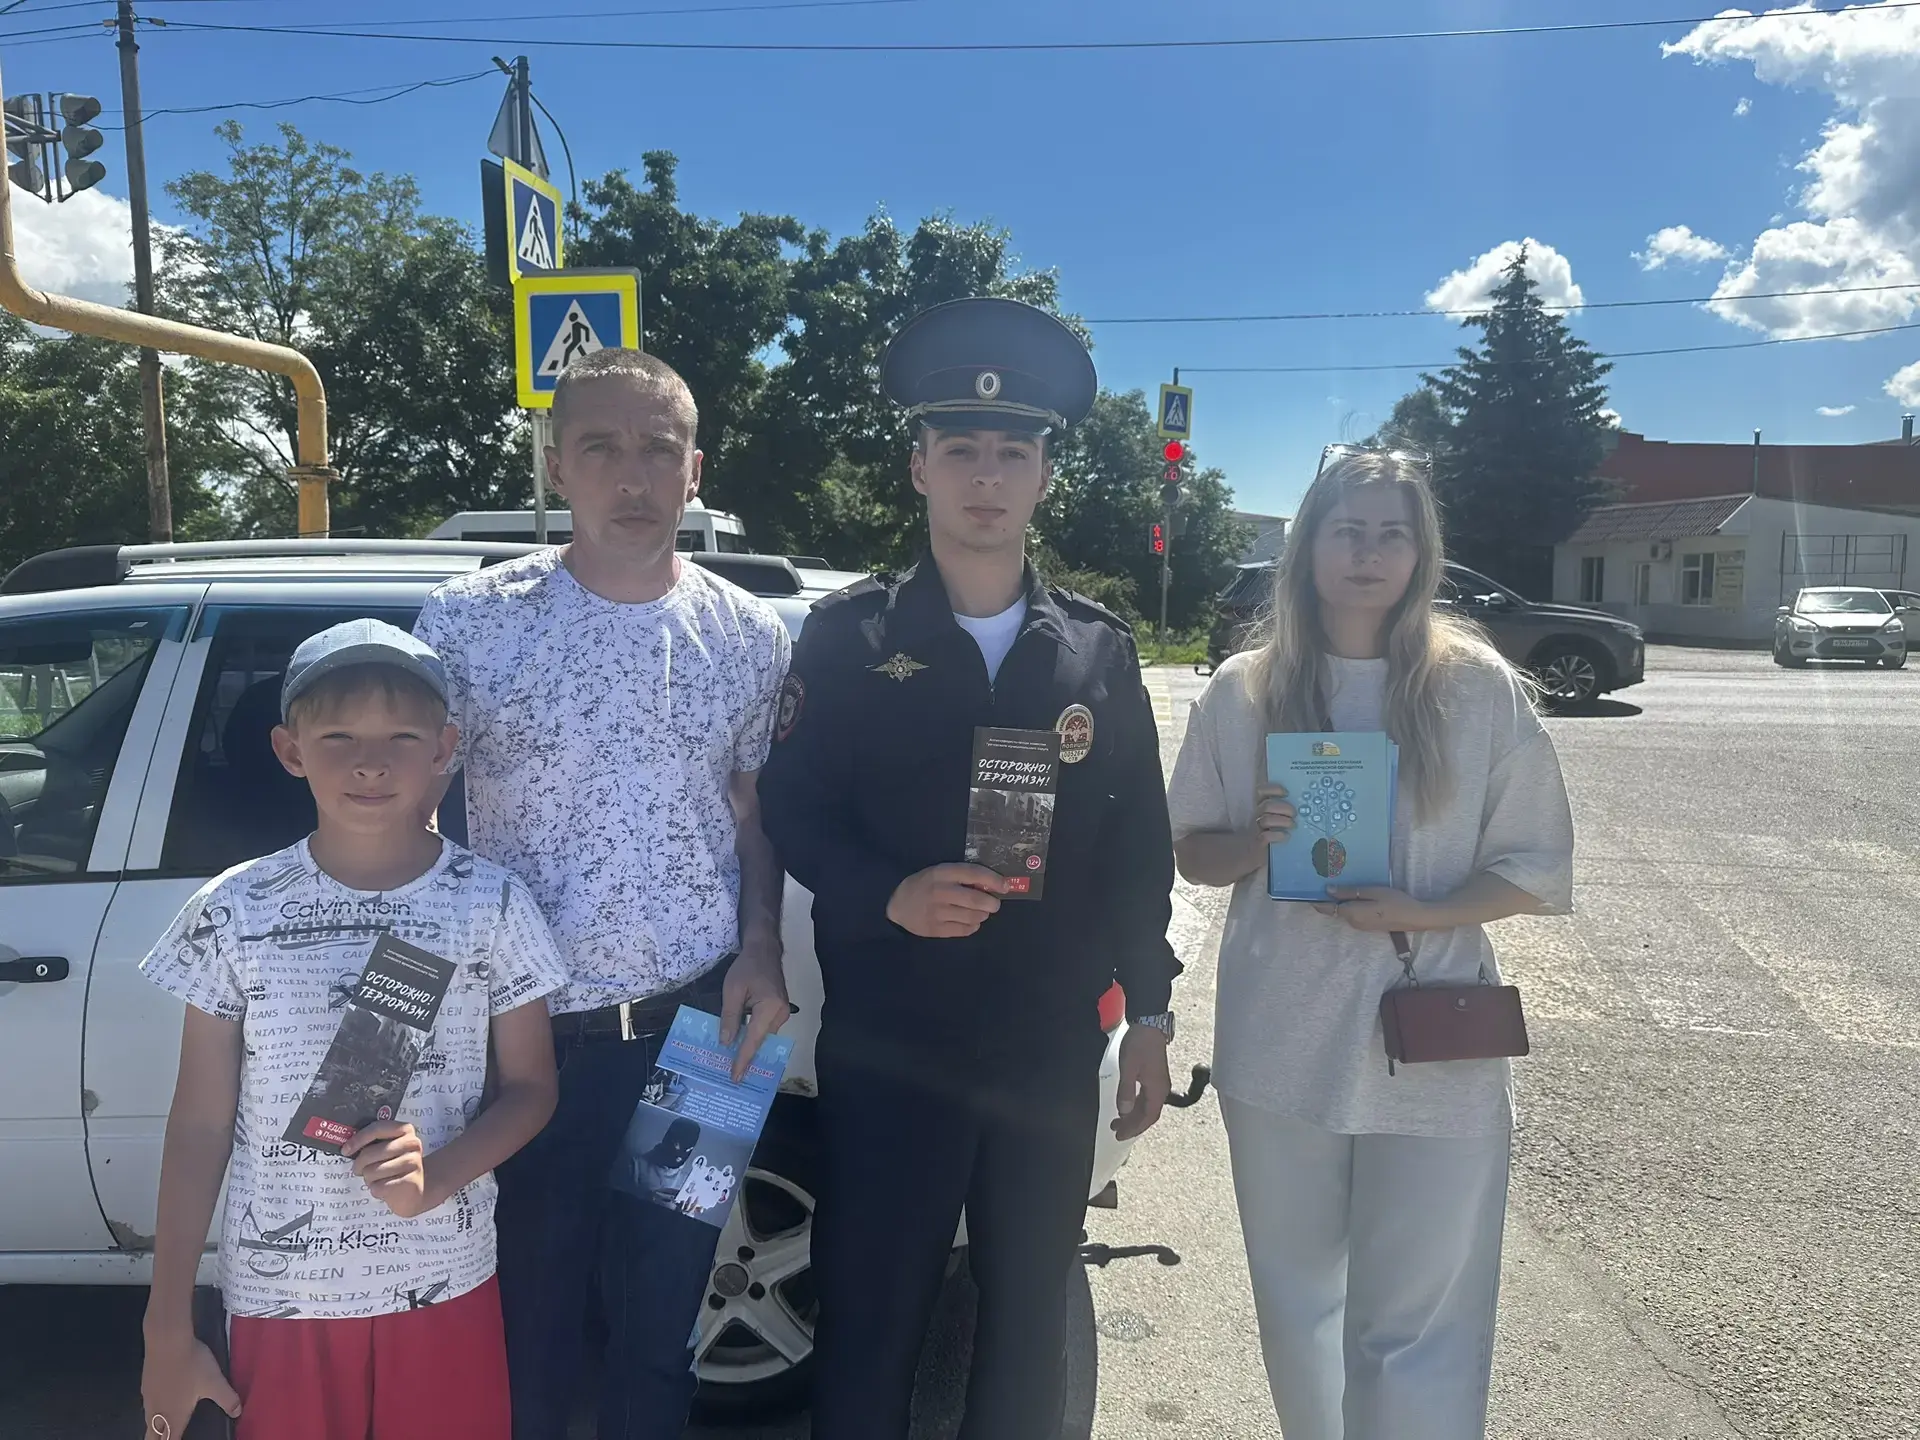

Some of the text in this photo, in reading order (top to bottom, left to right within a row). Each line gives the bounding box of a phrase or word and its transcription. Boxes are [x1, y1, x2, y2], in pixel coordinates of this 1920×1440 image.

[978, 758, 1051, 774] ОСТОРОЖНО!
[977, 770, 1051, 787] ТЕРРОРИЗМ!
[474, 885, 501, 895] LEIN
[244, 901, 280, 912] CALVIN
[280, 895, 351, 919] Calvin
[290, 952, 330, 960] JEANS
[342, 950, 370, 960] CALV
[307, 967, 351, 975] CALVIN
[512, 973, 533, 988] JEANS
[186, 977, 202, 1001] CALV
[366, 971, 435, 1006] ОСТОРОЖНО!
[513, 980, 537, 998] CALVIN
[201, 986, 217, 1011] LEIN
[359, 986, 430, 1020] ТЕРРОРИЗМ!
[247, 1009, 279, 1020] JEANS
[288, 1006, 326, 1015] CALVIN
[254, 1023, 338, 1037] JEANS CALVIN
[258, 1041, 294, 1051] KLEIN
[268, 1051, 305, 1060] KLEIN
[421, 1053, 447, 1061] JEANS
[263, 1060, 310, 1071] CALVIN
[280, 1072, 317, 1082] EANS
[425, 1085, 465, 1094] CALVI
[270, 1092, 306, 1104] JEA
[327, 1123, 348, 1135] ЕДДС
[323, 1131, 348, 1143] Полиц
[281, 1184, 314, 1192] KLEIN
[329, 1199, 369, 1209] CALVIN
[332, 1212, 366, 1221] KLEIN
[373, 1210, 393, 1218] JEA
[426, 1213, 459, 1226] JEANS
[385, 1219, 419, 1227] CALVIN
[261, 1227, 399, 1251] Calvin Klein
[430, 1234, 457, 1242] JEANS
[367, 1246, 410, 1254] JEANS
[443, 1243, 475, 1254] CALVIN
[294, 1267, 344, 1280] KLEIN
[362, 1263, 411, 1276] JEANS
[418, 1260, 444, 1268] CALVIN
[243, 1285, 270, 1294] CALVIN
[309, 1291, 371, 1302] KLEIN
[313, 1306, 373, 1317] CALVIN
